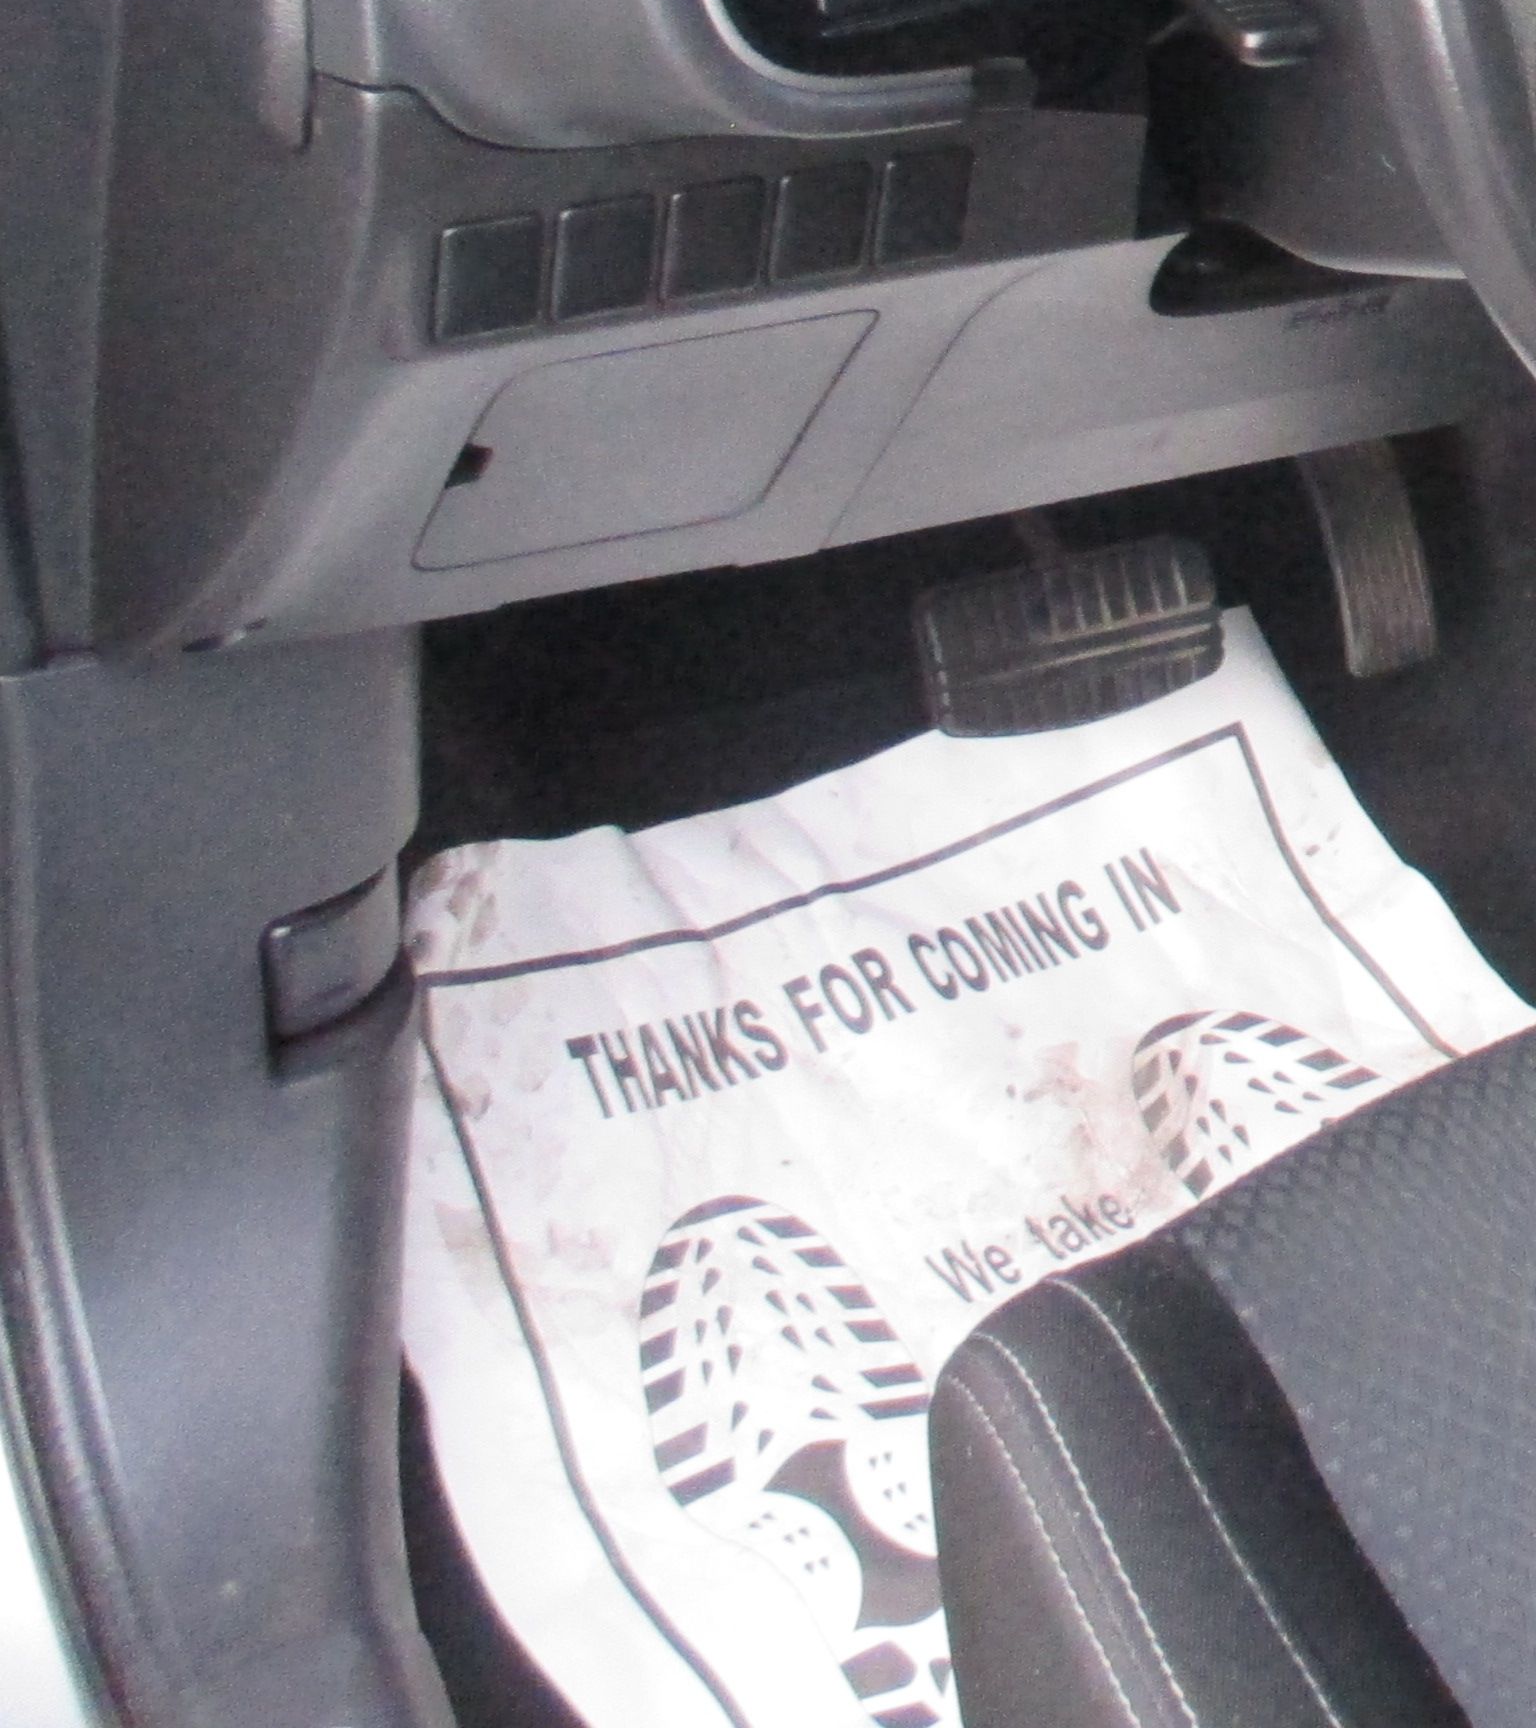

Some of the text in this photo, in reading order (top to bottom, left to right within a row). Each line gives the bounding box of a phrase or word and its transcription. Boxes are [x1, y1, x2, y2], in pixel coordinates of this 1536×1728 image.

[566, 846, 1183, 1120] THANKS FOR COMING IN
[923, 1191, 1138, 1304] We take
